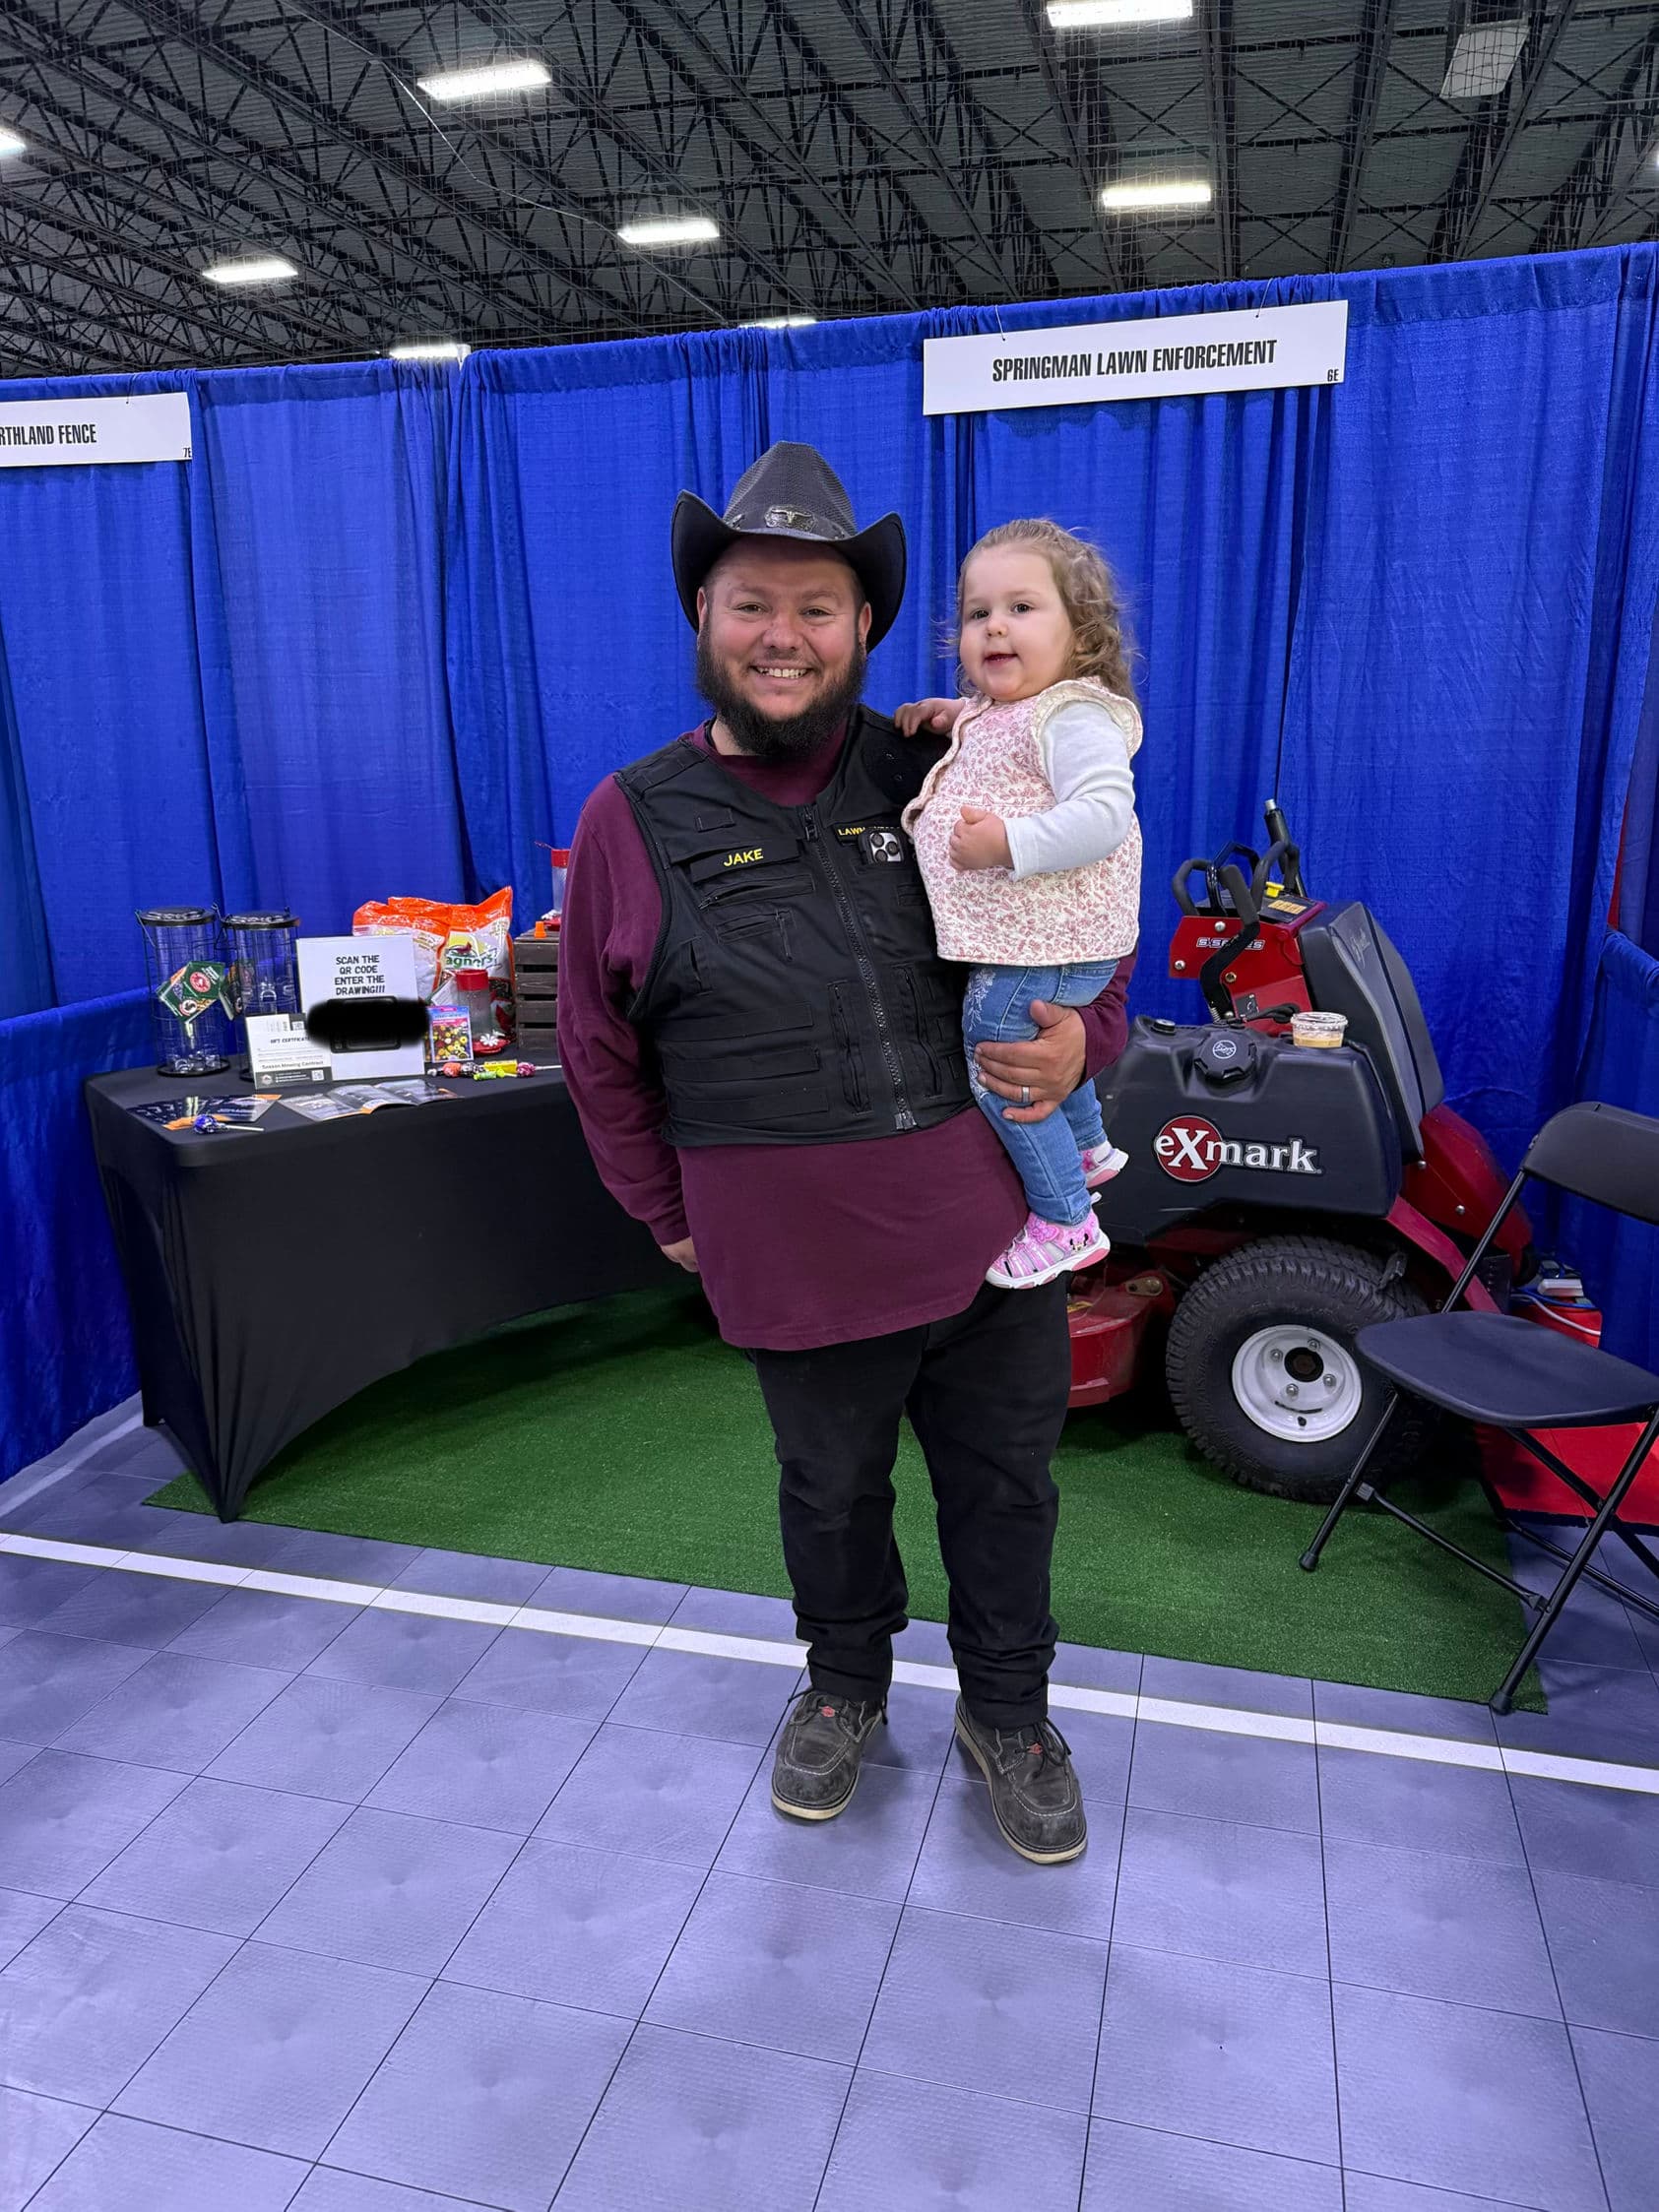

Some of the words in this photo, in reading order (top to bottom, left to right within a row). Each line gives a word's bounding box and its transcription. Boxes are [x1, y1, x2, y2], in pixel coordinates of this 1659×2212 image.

[992, 353, 1091, 381] SPRINGMAN
[1097, 349, 1147, 375] LAWN
[1153, 340, 1277, 372] ENFORCEMENT
[1327, 368, 1339, 382] 6E
[58, 423, 97, 444] FENCE
[723, 848, 764, 867] JAKE
[336, 956, 359, 966] SCAN
[354, 965, 378, 974] CODE
[334, 977, 364, 985] ENTER
[366, 975, 385, 983] THE
[335, 985, 386, 996] DRAWING!!!
[1155, 1127, 1318, 1173] eXmark
